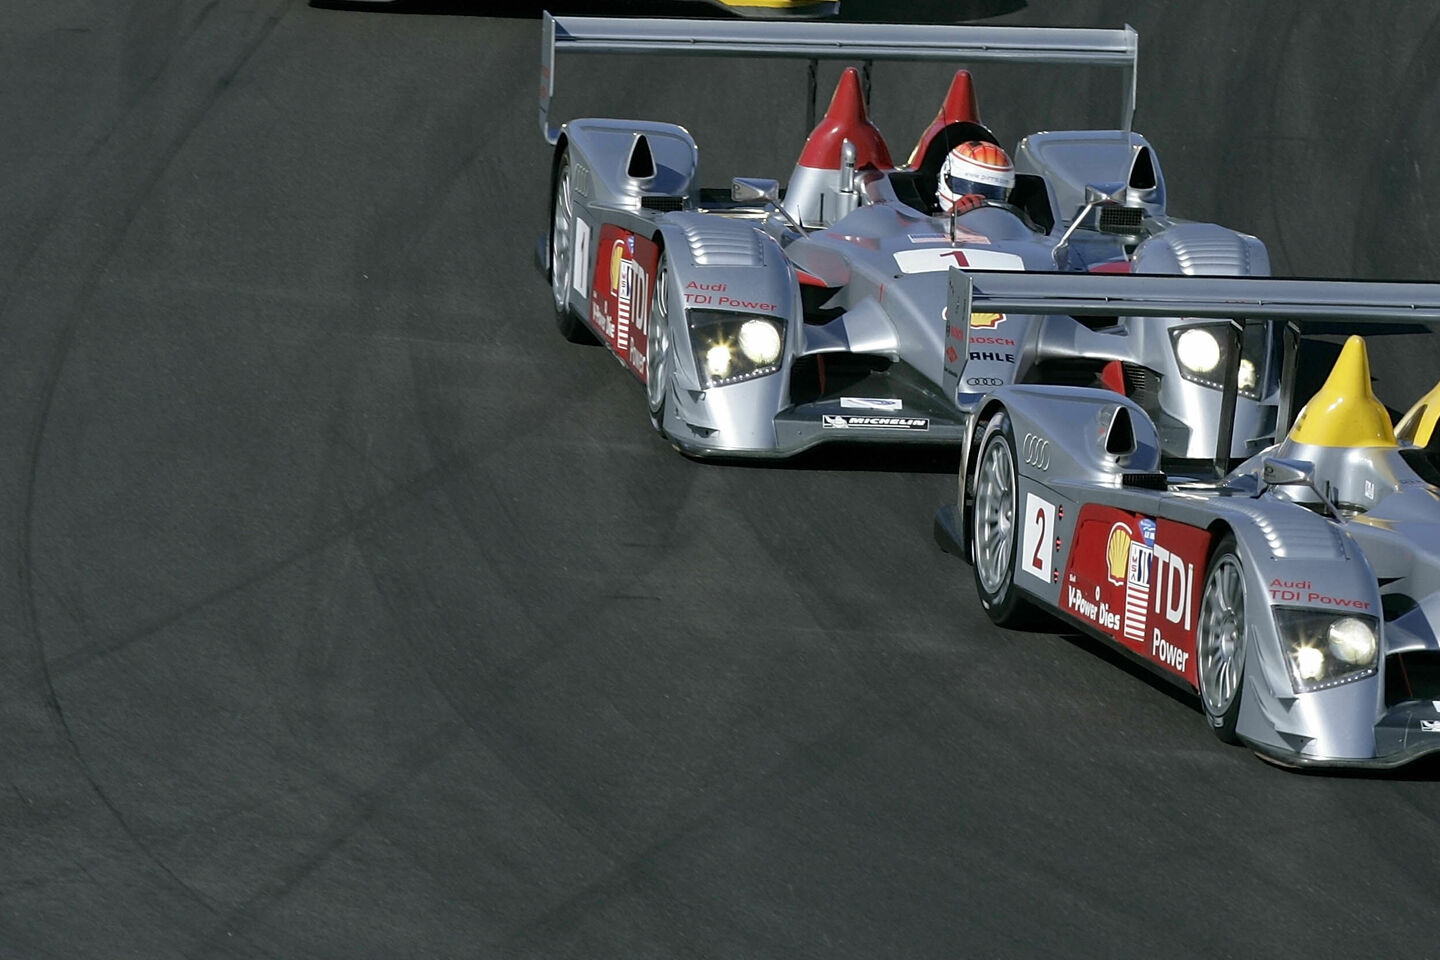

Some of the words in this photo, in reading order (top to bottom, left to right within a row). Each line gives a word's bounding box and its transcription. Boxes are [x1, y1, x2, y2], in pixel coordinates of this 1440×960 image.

[939, 250, 970, 267] 1
[686, 280, 728, 292] Audi
[684, 293, 712, 304] TDI
[718, 296, 779, 312] Power
[969, 351, 1016, 364] AHLE
[848, 416, 927, 427] MICHELIN
[1031, 507, 1046, 571] 2
[1153, 542, 1194, 631] TDI
[1269, 578, 1312, 590] Audi
[1067, 584, 1098, 621] V-Power
[1269, 589, 1301, 601] TDI
[1307, 592, 1371, 609] Power
[1151, 627, 1189, 673] Power
